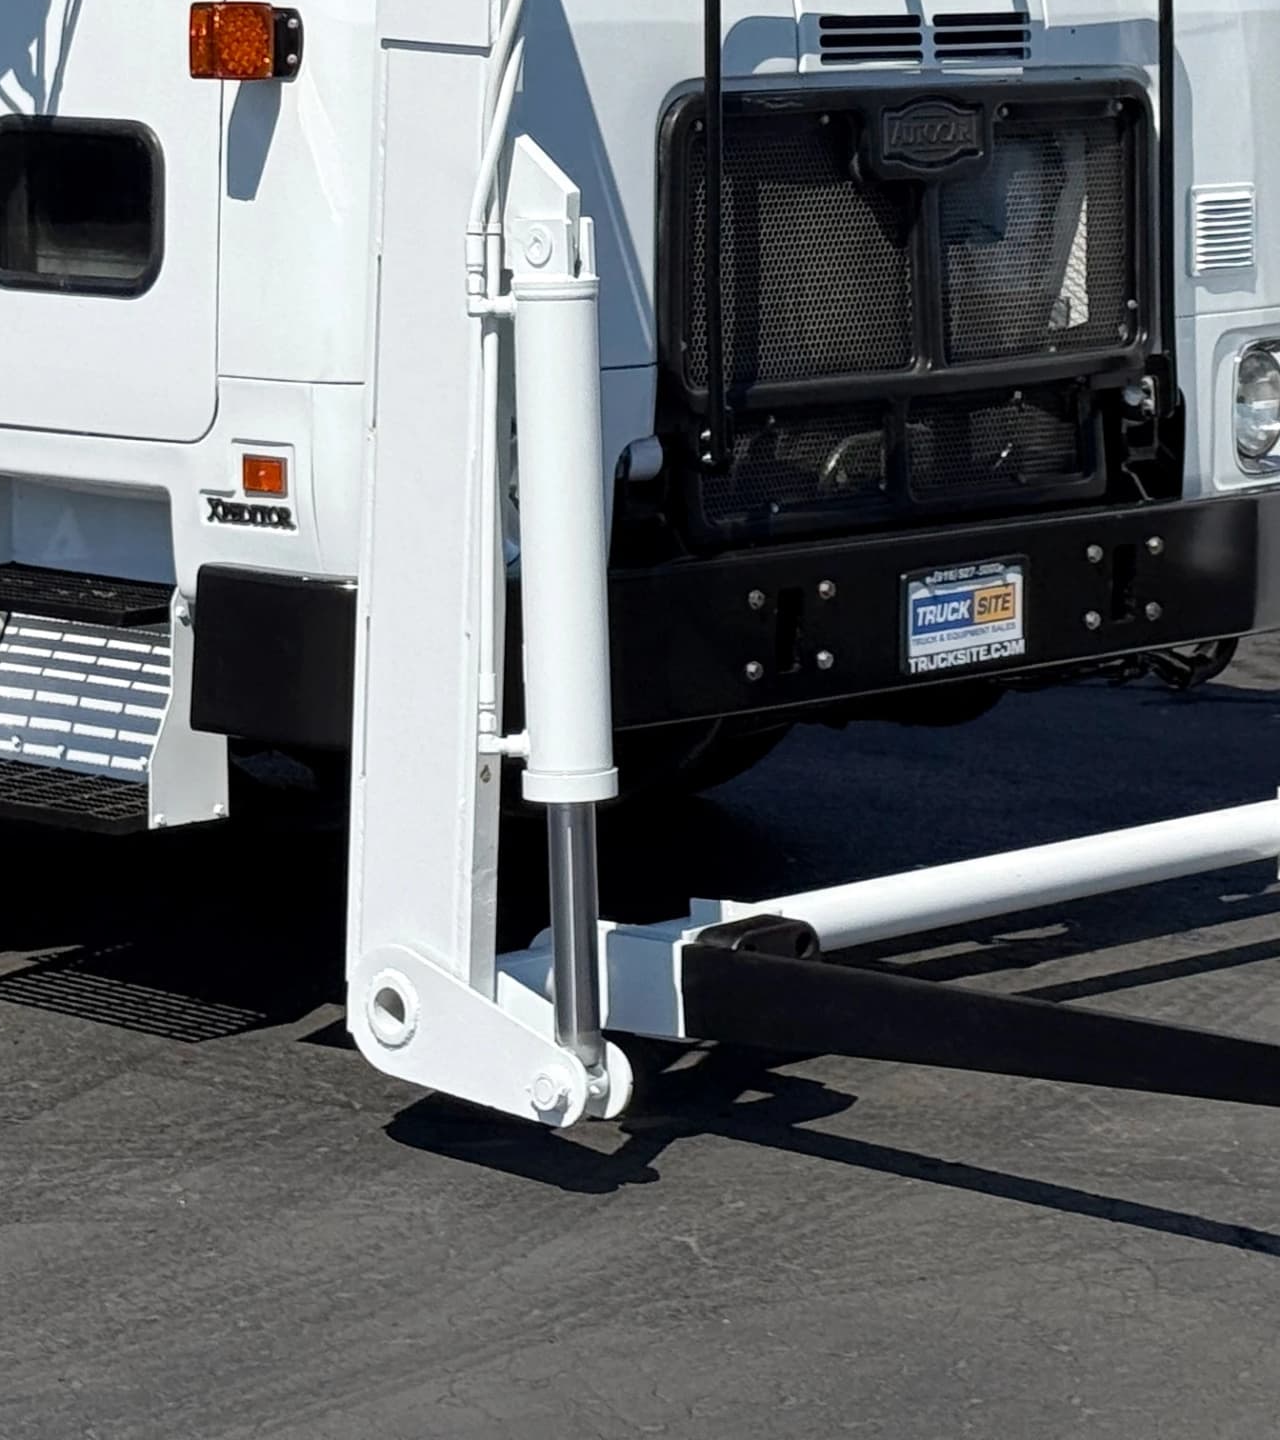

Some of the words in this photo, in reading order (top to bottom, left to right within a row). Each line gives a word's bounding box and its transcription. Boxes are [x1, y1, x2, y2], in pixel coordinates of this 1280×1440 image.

[891, 120, 973, 146] AUTOCAR
[916, 599, 972, 627] TRUCK
[976, 593, 1012, 616] SITE
[908, 639, 1025, 673] TRUCKSITE.COM
